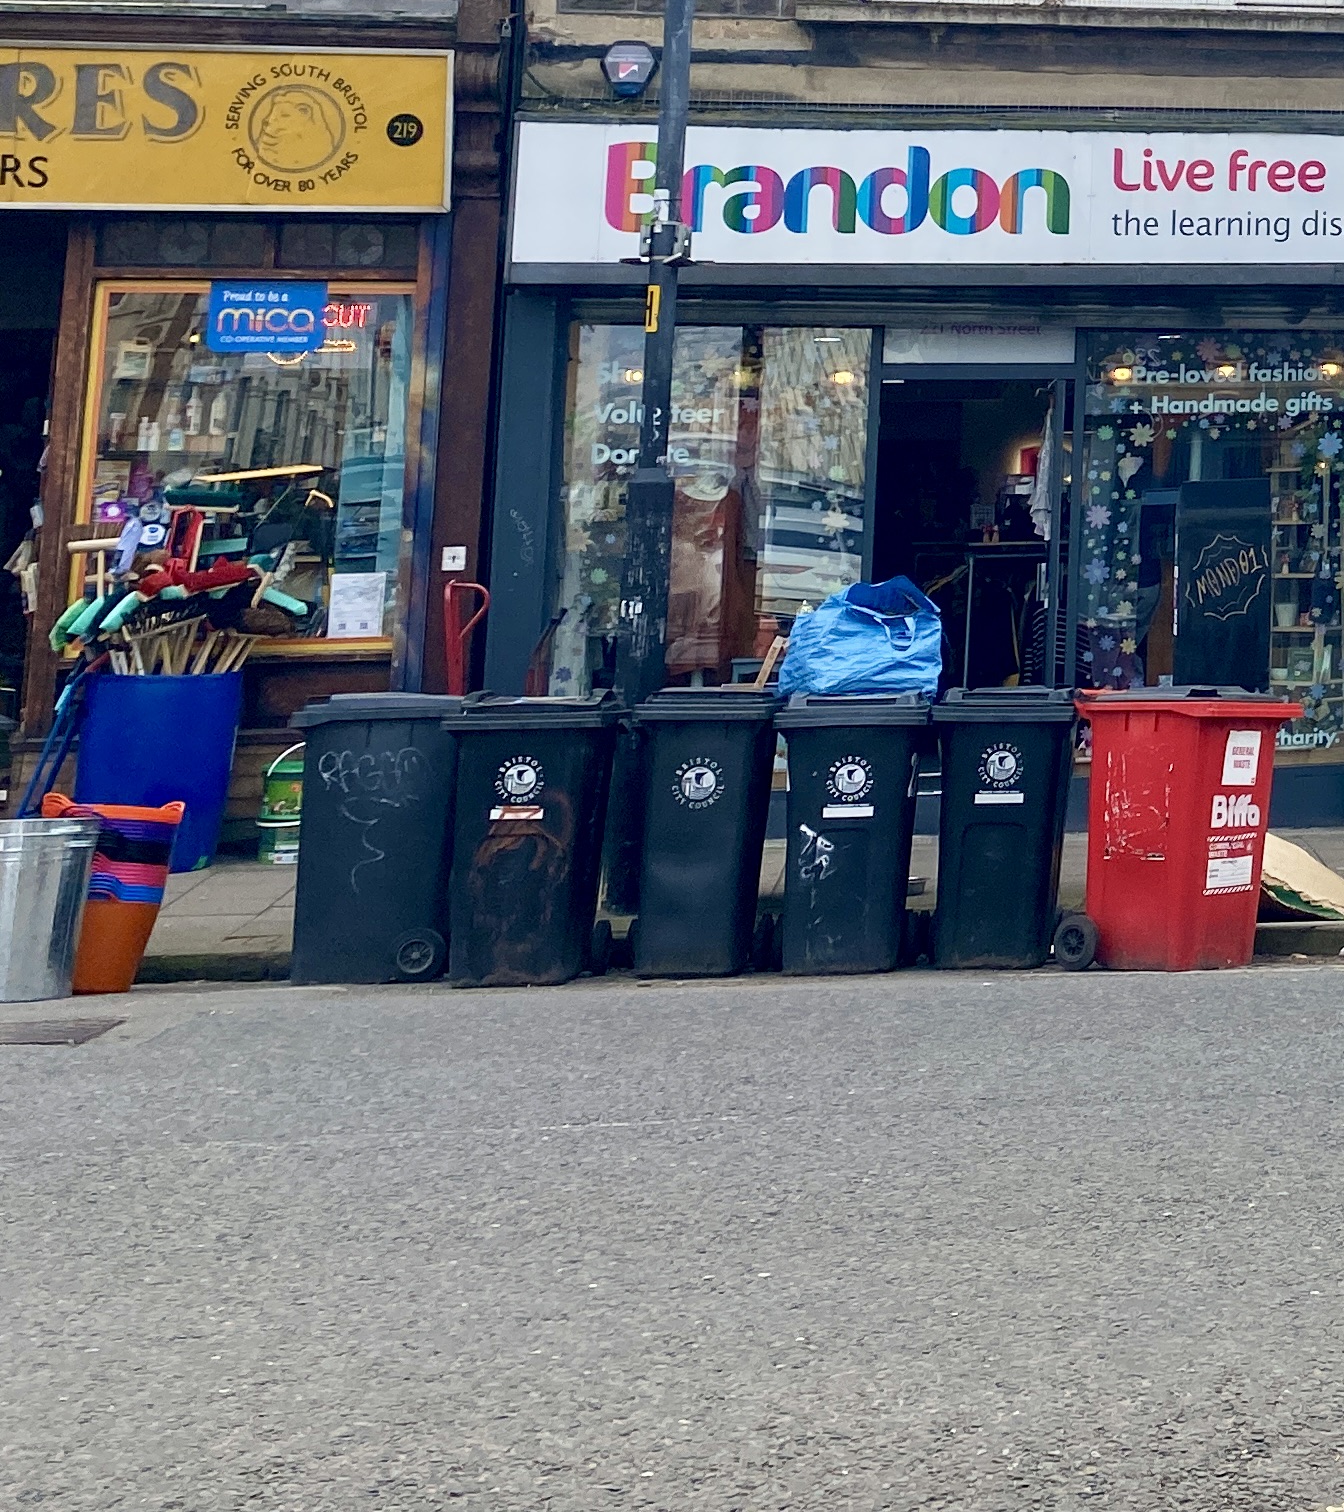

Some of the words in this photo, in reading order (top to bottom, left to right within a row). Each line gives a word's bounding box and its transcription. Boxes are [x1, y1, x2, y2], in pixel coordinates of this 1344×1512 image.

[225, 74, 267, 130] SERVING
[270, 63, 331, 83] SOUTH
[332, 77, 368, 133] BRISTOL
[392, 121, 418, 139] 219
[231, 147, 255, 175] FOR
[253, 172, 292, 193] OVER
[319, 151, 359, 185] YEARS
[1112, 147, 1215, 193] Live
[1228, 148, 1327, 193] free
[604, 141, 1071, 235] Brandon
[1111, 210, 1160, 237] the
[1172, 209, 1291, 243] learning
[223, 290, 252, 303] Proud
[254, 291, 266, 302] to
[267, 291, 279, 302] be
[216, 308, 316, 333] mica
[1132, 363, 1242, 384] Pre-loved
[1248, 362, 1332, 383] fashion
[594, 400, 725, 426] Voluteer
[1129, 401, 1143, 415] +
[1151, 393, 1280, 415] Handmade
[1285, 392, 1334, 417] gifts
[590, 443, 690, 465] Donte
[981, 742, 1022, 759] BRISTOL
[498, 756, 543, 773] BRISTOL
[675, 757, 723, 775] BRISTOL
[829, 755, 872, 773] BRISTOL
[993, 766, 1024, 789] COUNCIL
[510, 781, 545, 804] COUNCIL
[688, 785, 725, 809] COUNCIL
[841, 779, 874, 802] COUNCIL
[1210, 793, 1260, 829] Biffa
